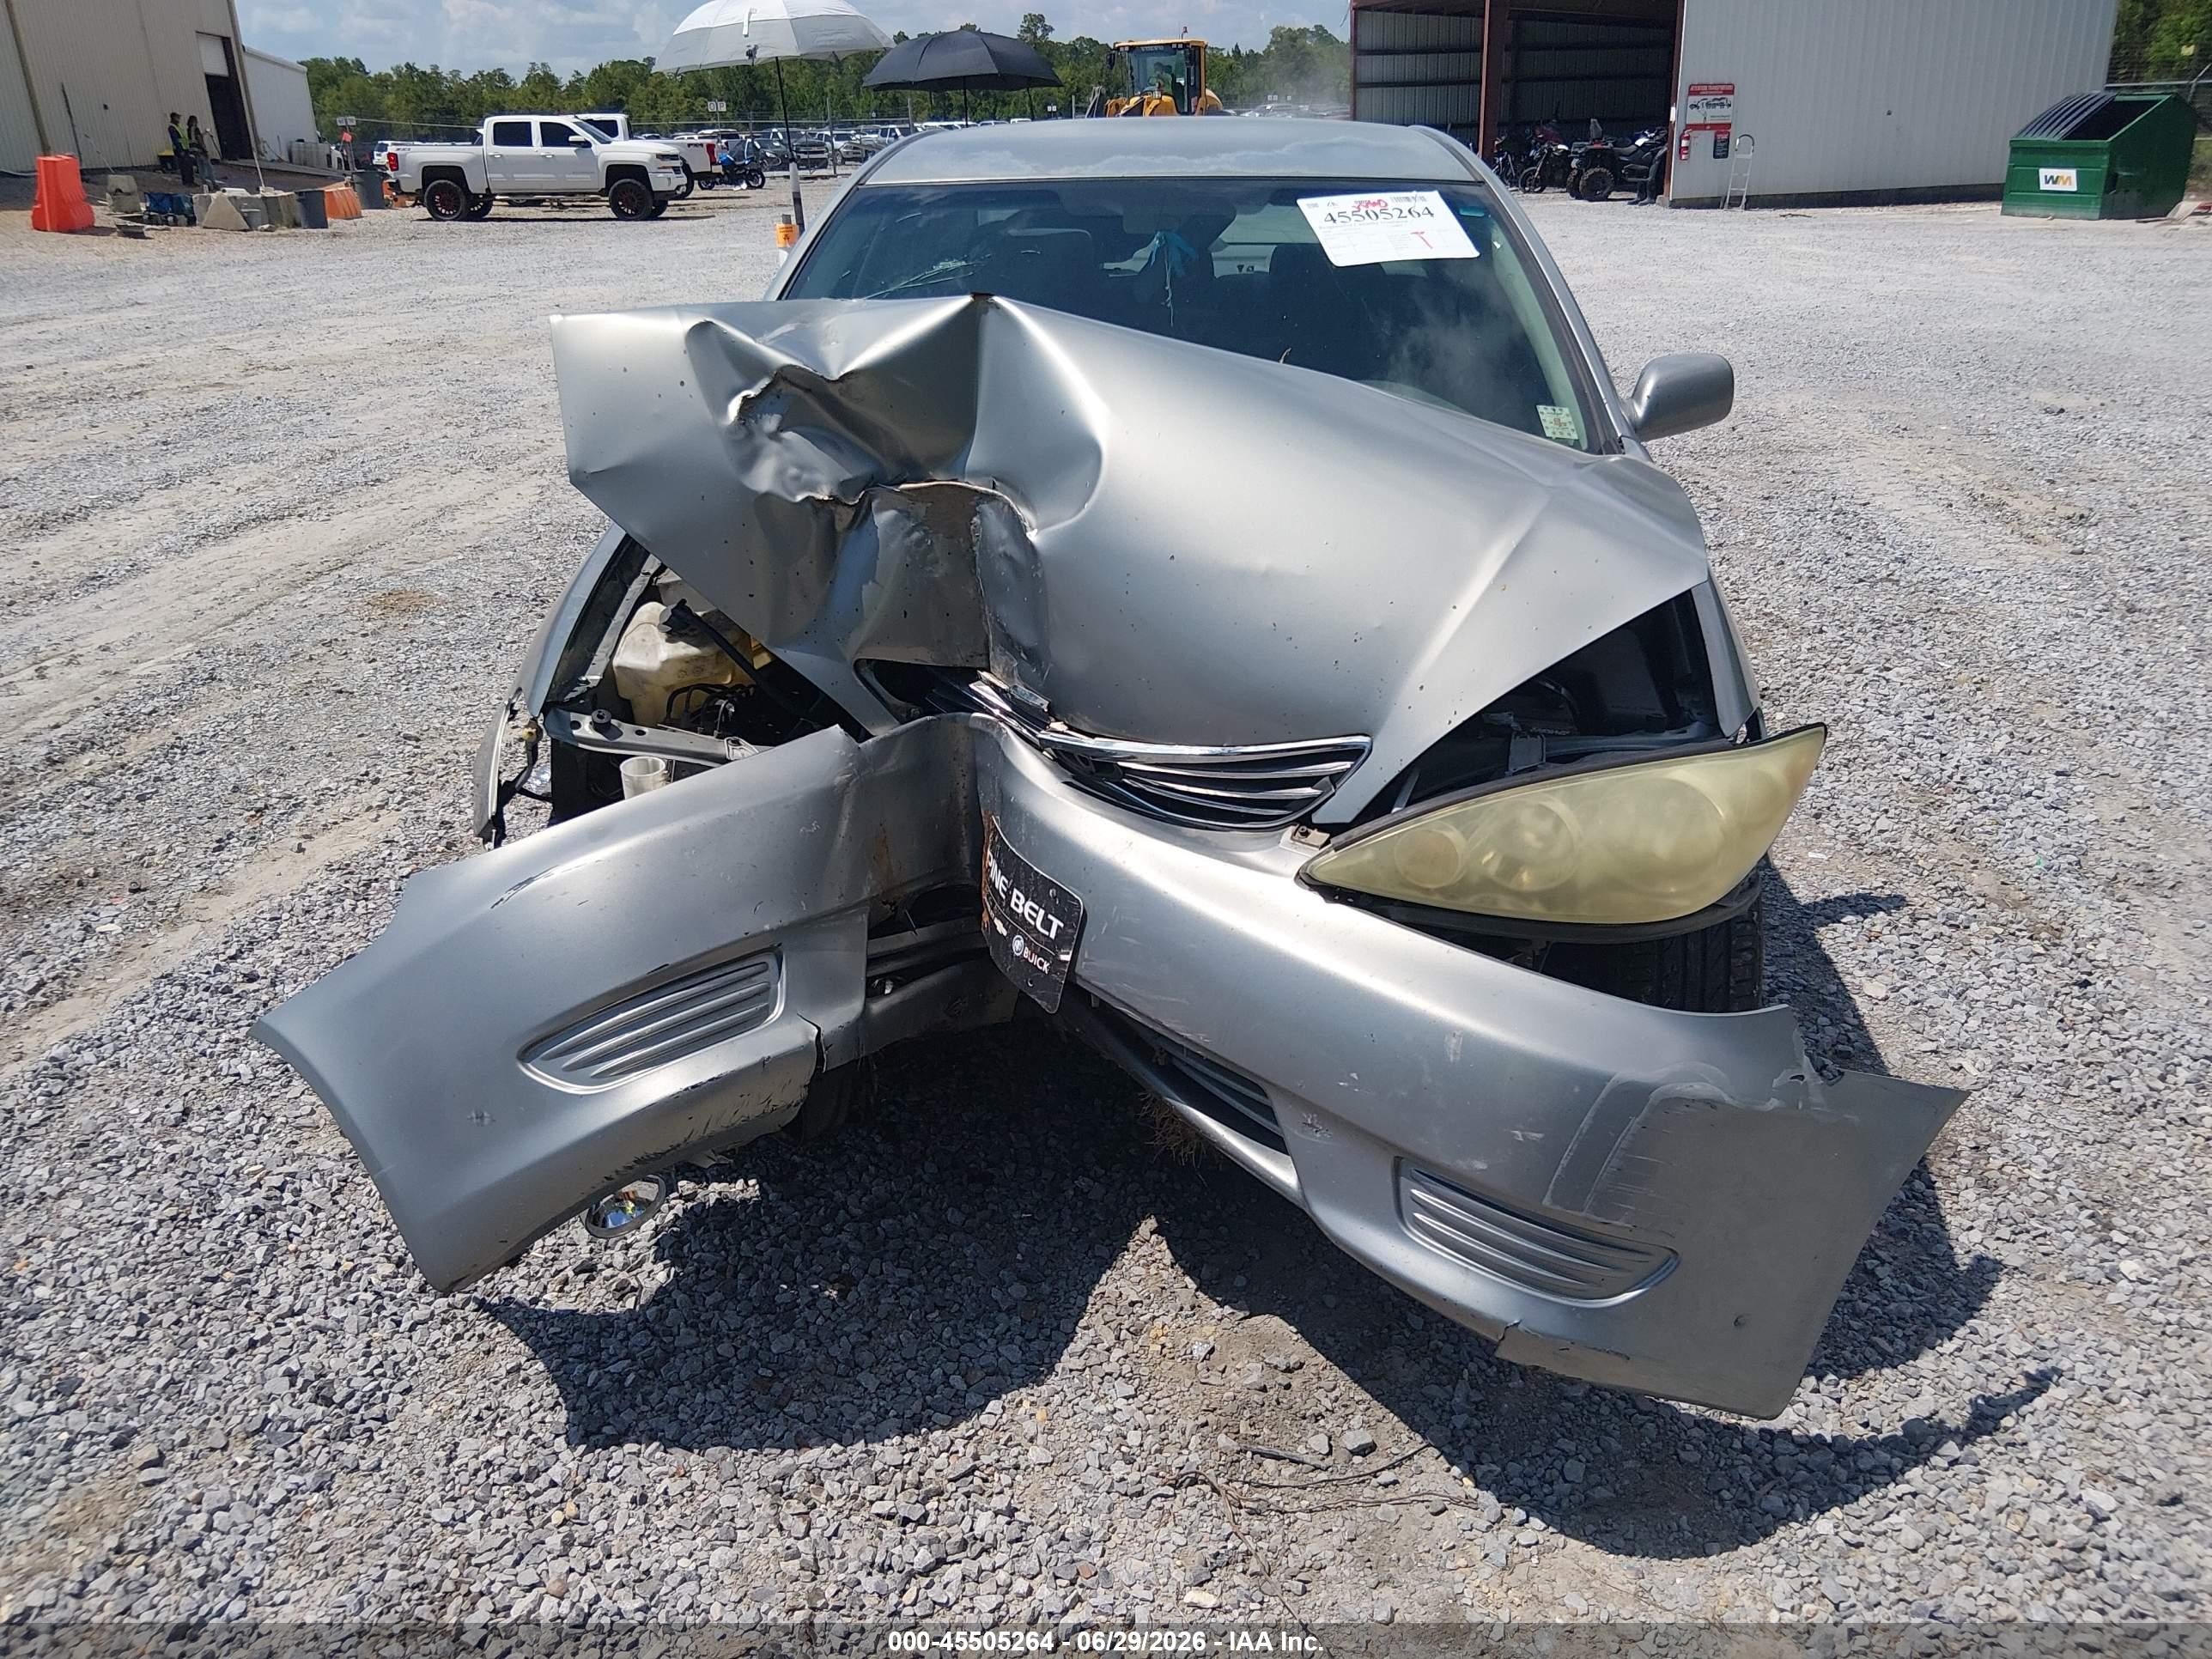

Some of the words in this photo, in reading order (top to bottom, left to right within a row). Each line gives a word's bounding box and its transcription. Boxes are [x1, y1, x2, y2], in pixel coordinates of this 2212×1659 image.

[2044, 174, 2072, 185] WM
[1324, 206, 1435, 224] 45505264
[1010, 887, 1065, 940] BELT
[1023, 946, 1050, 975] BUICK
